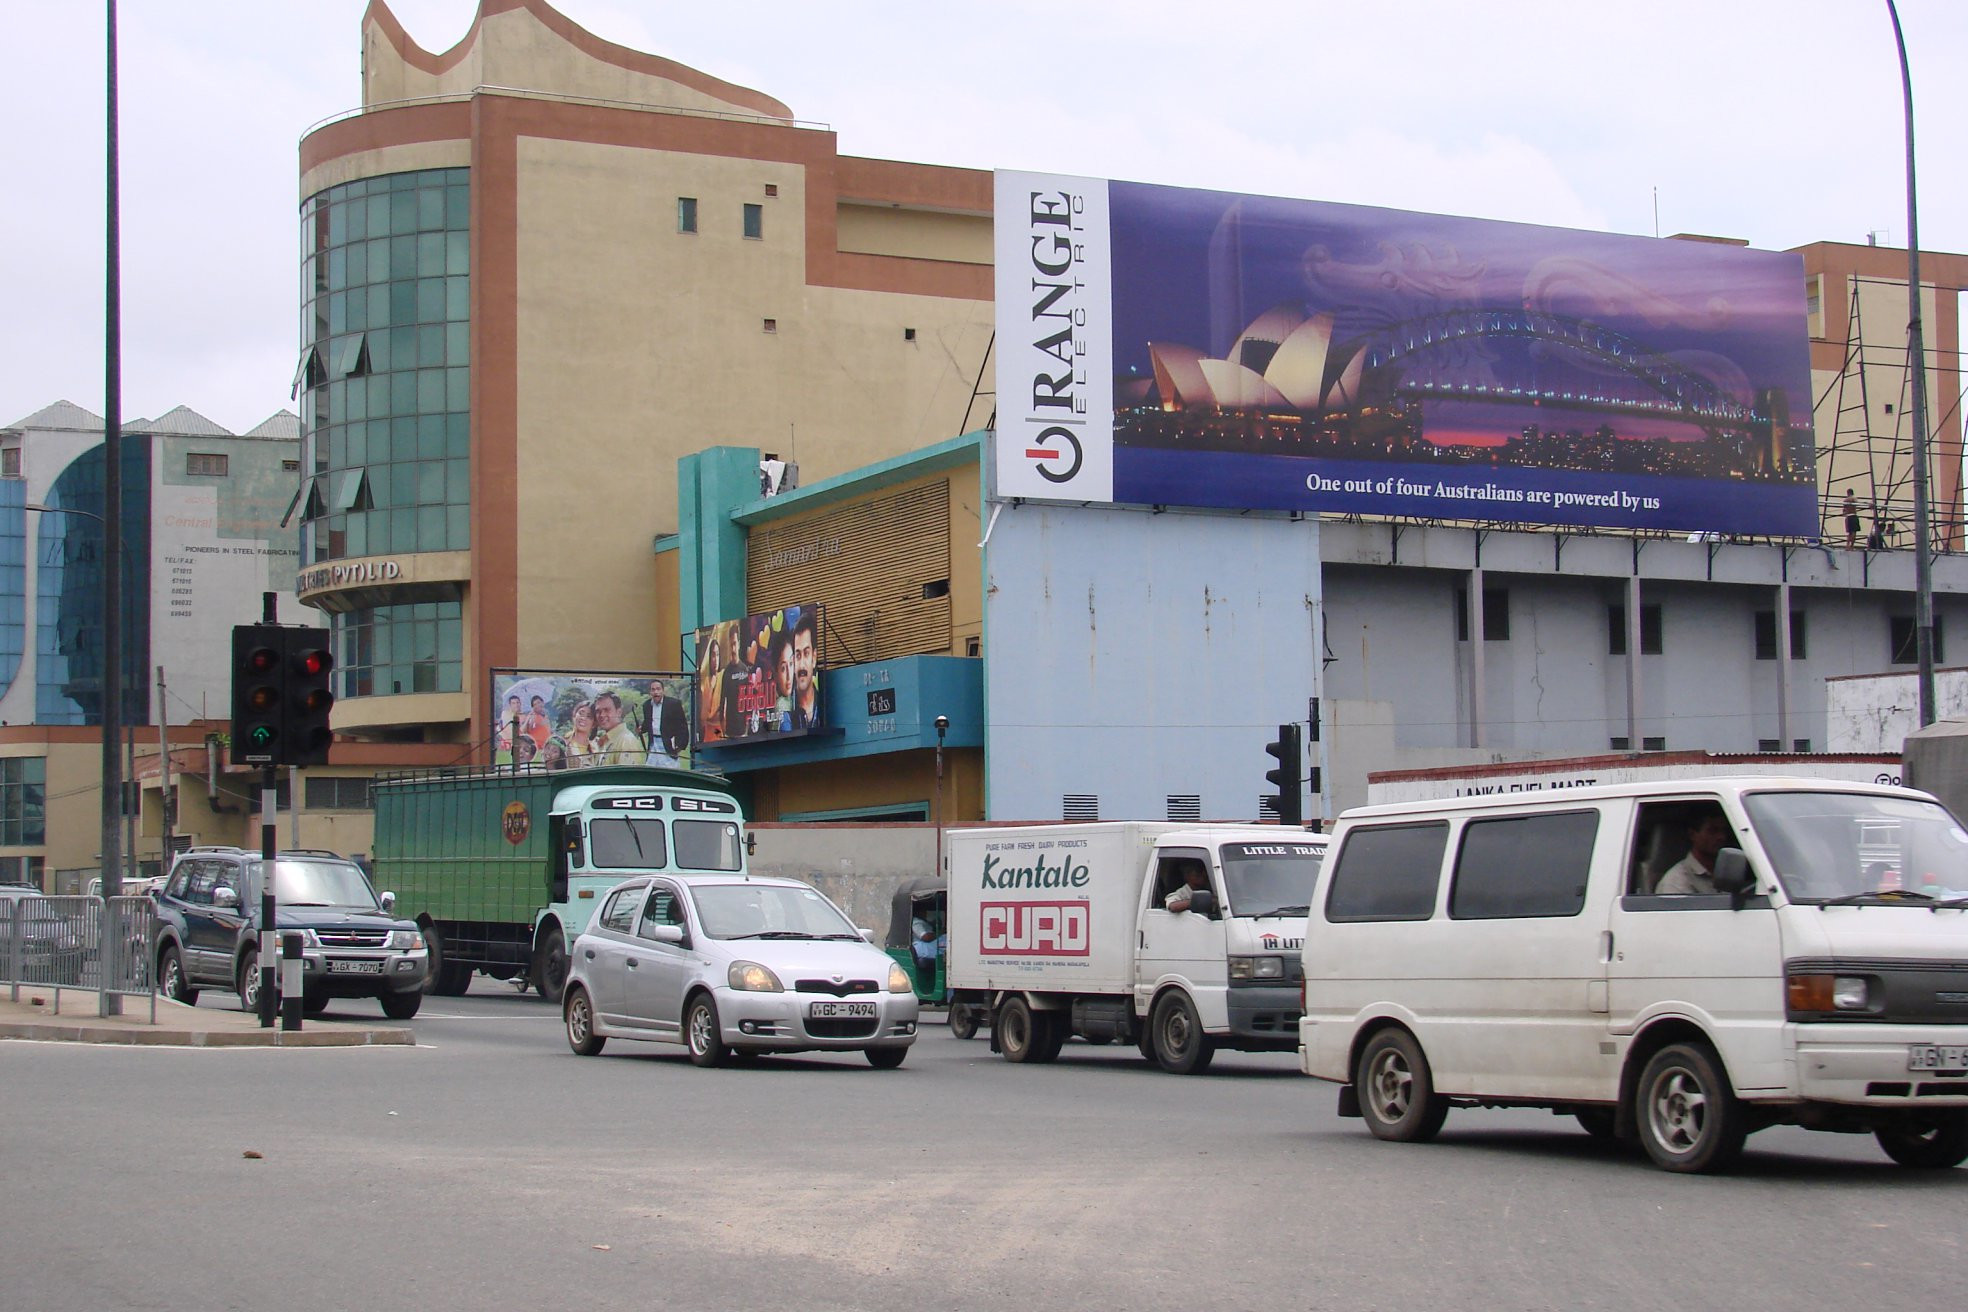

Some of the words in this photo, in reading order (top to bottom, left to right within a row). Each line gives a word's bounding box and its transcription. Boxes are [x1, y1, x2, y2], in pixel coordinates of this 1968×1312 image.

[1072, 194, 1087, 414] ELECTRIC
[1306, 473, 1341, 491] One
[1344, 478, 1372, 493] out
[1375, 477, 1394, 495] of
[1396, 478, 1432, 497] four
[1433, 481, 1524, 502] Australians
[1526, 490, 1551, 503] are
[1553, 490, 1619, 508] powered
[1622, 491, 1641, 512] by
[1643, 496, 1661, 509] us
[185, 546, 220, 554] PIONEERS
[985, 843, 1000, 852] PURE
[1017, 842, 1035, 850] FRESH
[1057, 840, 1088, 848] PRODUCTS
[1242, 846, 1287, 855] LITTLE
[1292, 846, 1328, 856] TRAD
[981, 853, 1090, 889] Kantale
[982, 906, 1087, 951] CURD
[848, 1004, 873, 1015] 9494
